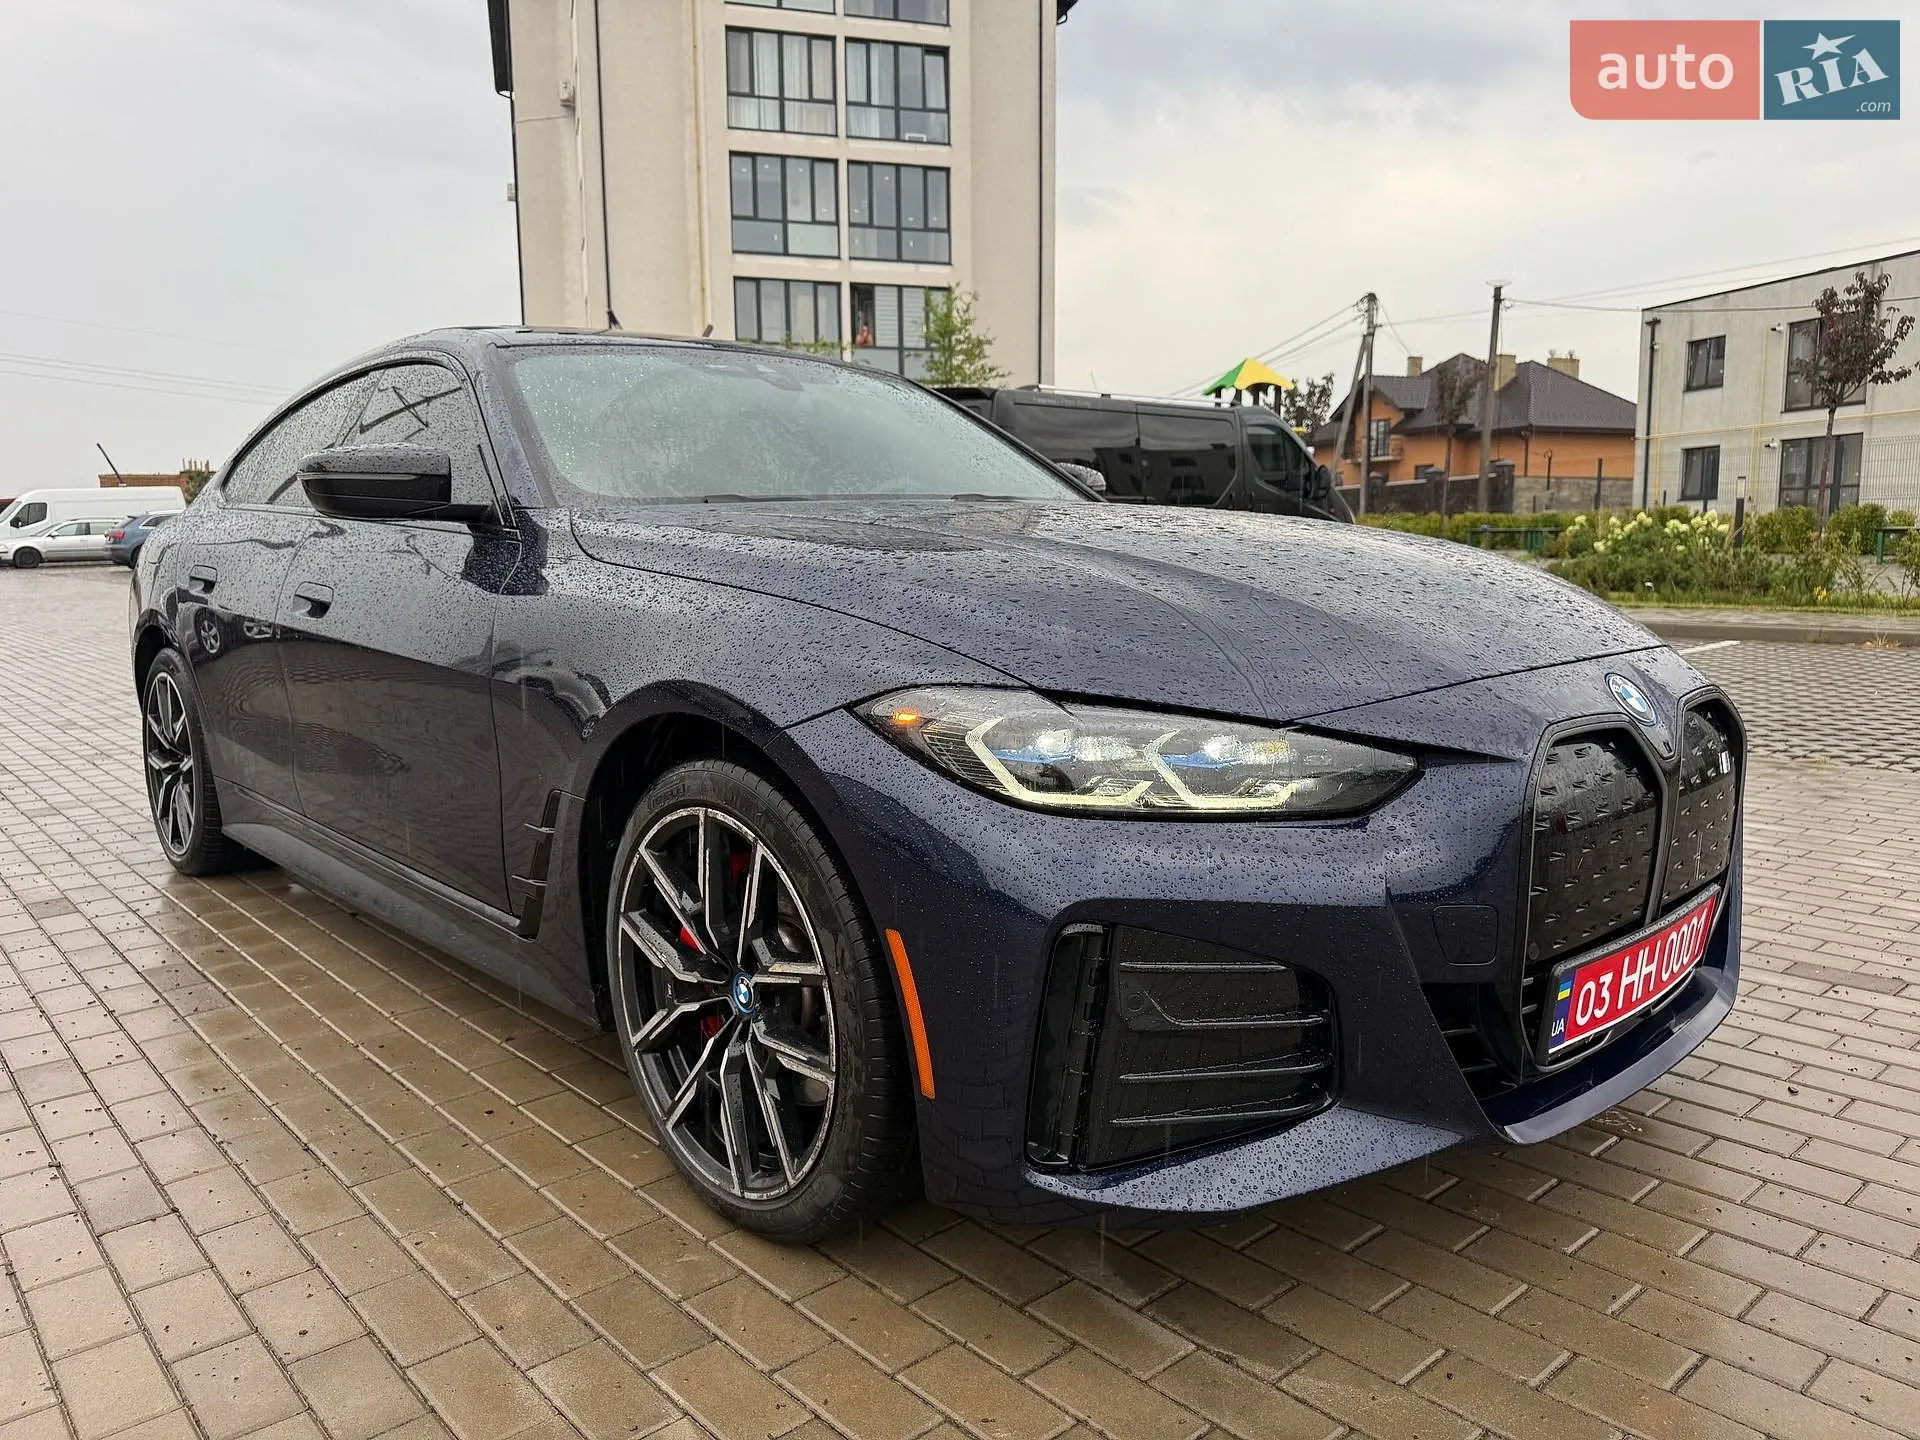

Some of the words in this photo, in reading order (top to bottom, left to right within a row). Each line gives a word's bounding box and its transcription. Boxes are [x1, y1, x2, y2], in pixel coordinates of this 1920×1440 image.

[1576, 972, 1614, 1026] 03
[1617, 940, 1662, 1010] HH
[1661, 908, 1708, 982] 0001
[1551, 1018, 1565, 1036] UA
